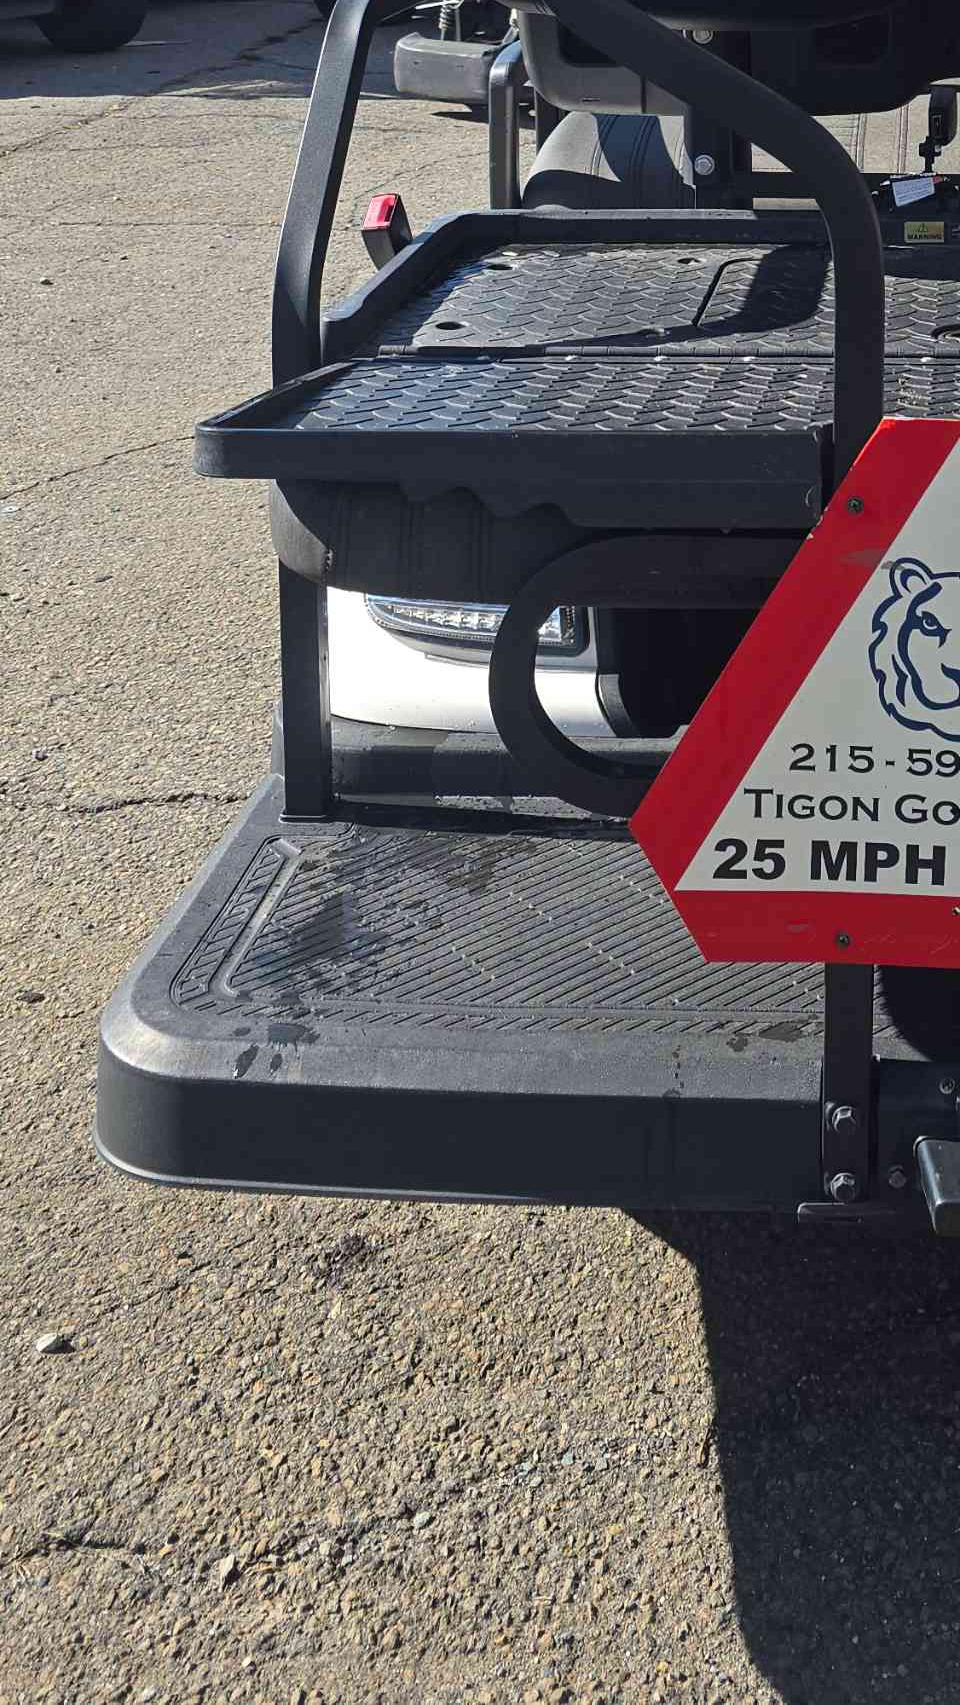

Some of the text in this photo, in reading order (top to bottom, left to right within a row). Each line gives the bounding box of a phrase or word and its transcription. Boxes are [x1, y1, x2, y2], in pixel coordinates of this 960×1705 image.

[744, 788, 880, 822] TIGON
[712, 838, 786, 880] 25
[810, 840, 946, 886] MPH
